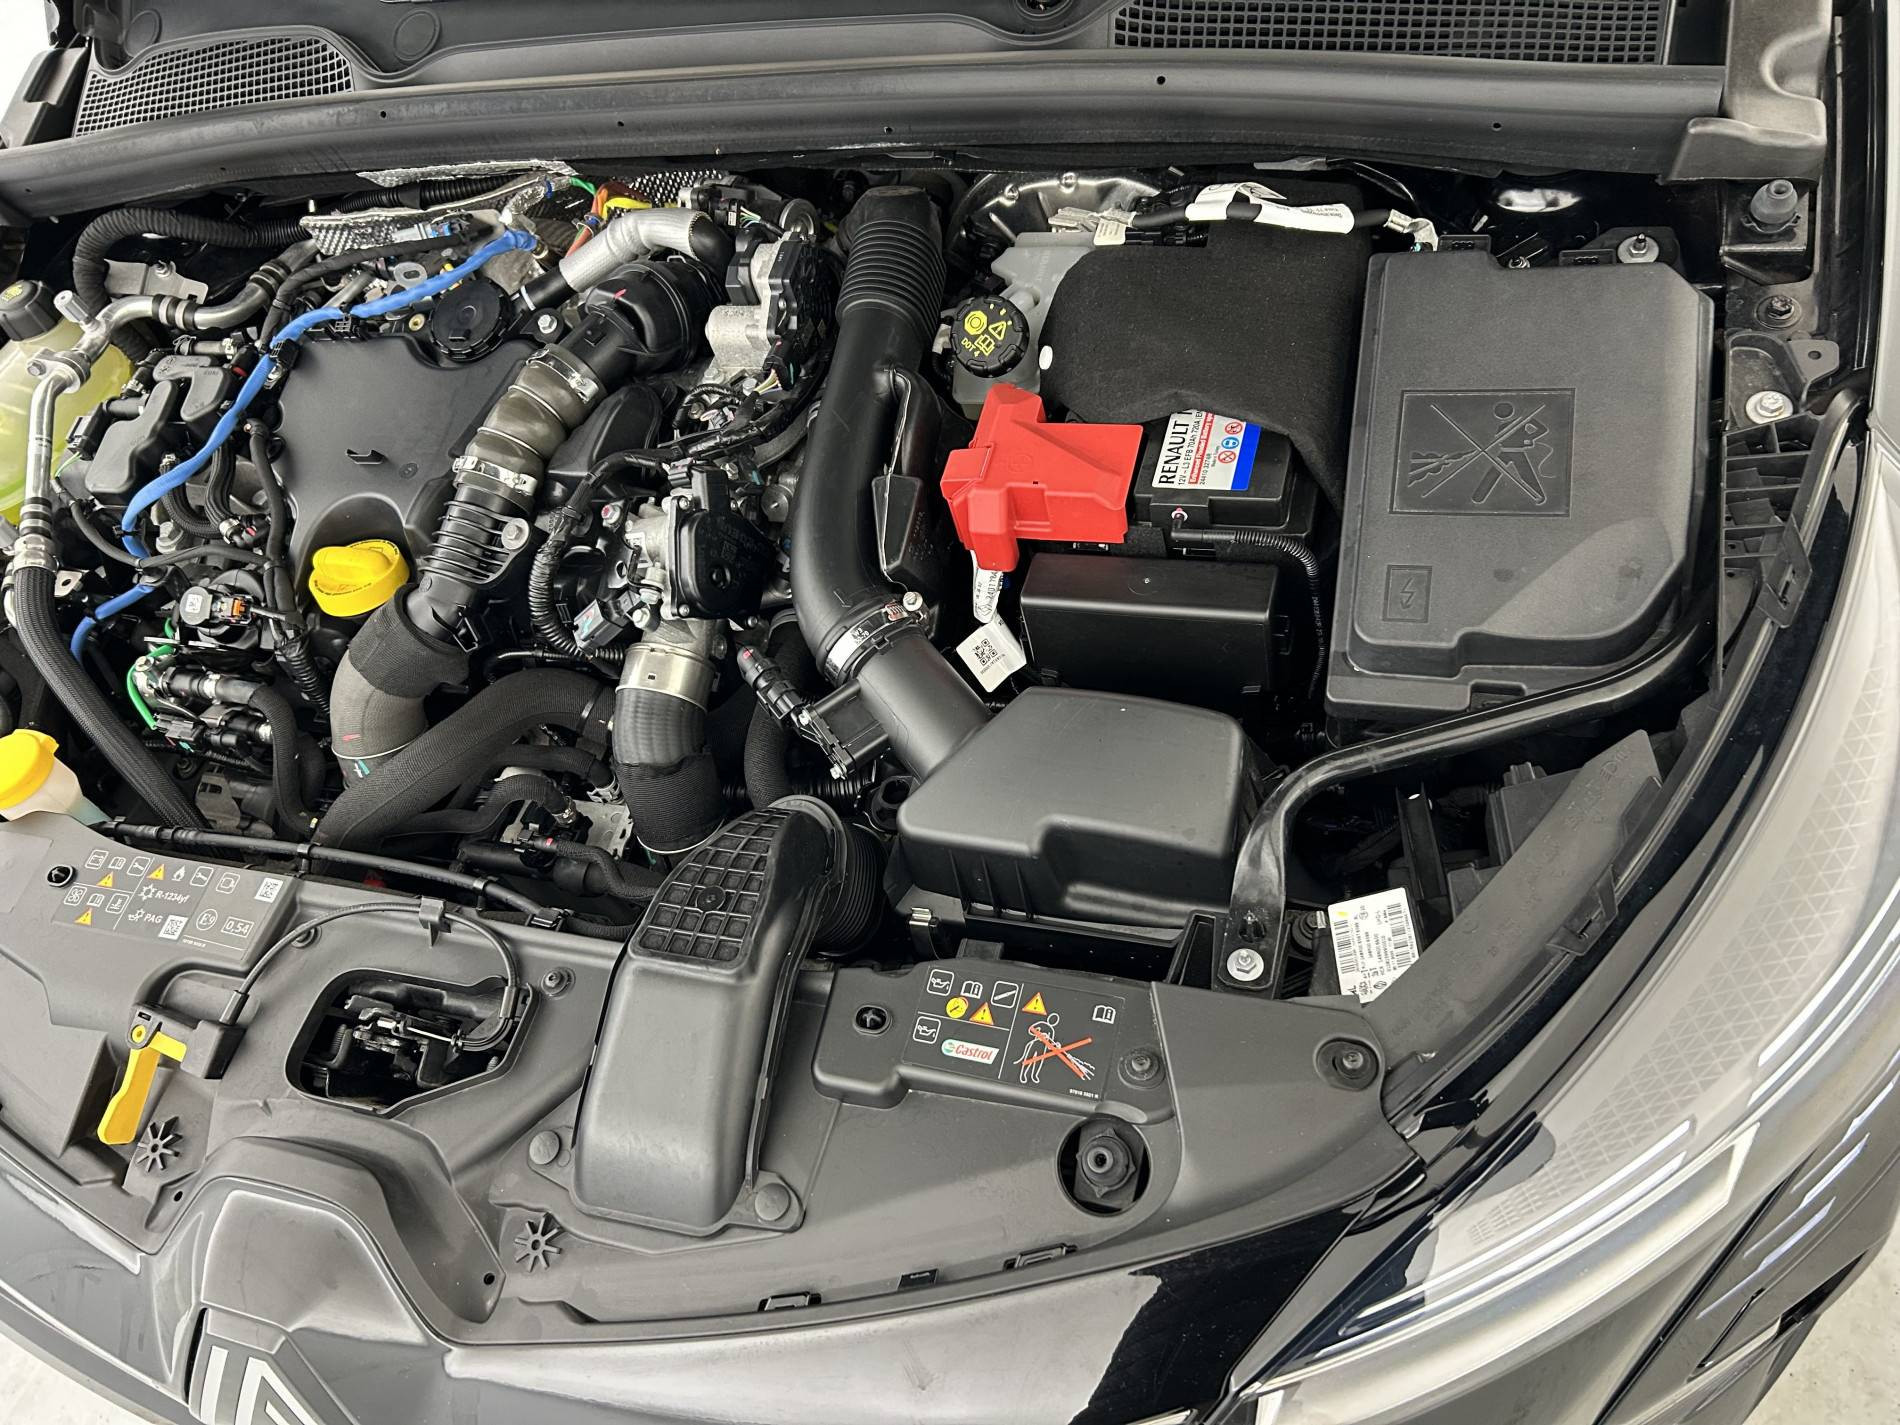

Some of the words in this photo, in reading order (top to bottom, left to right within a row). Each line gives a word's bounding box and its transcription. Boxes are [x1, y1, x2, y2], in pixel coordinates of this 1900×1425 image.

[961, 337, 976, 352] DOT
[1158, 420, 1190, 484] RENAULT
[155, 890, 190, 903] R-1234yf
[144, 911, 163, 924] PAG
[225, 920, 250, 934] 0,54
[955, 1044, 993, 1061] Castrol
